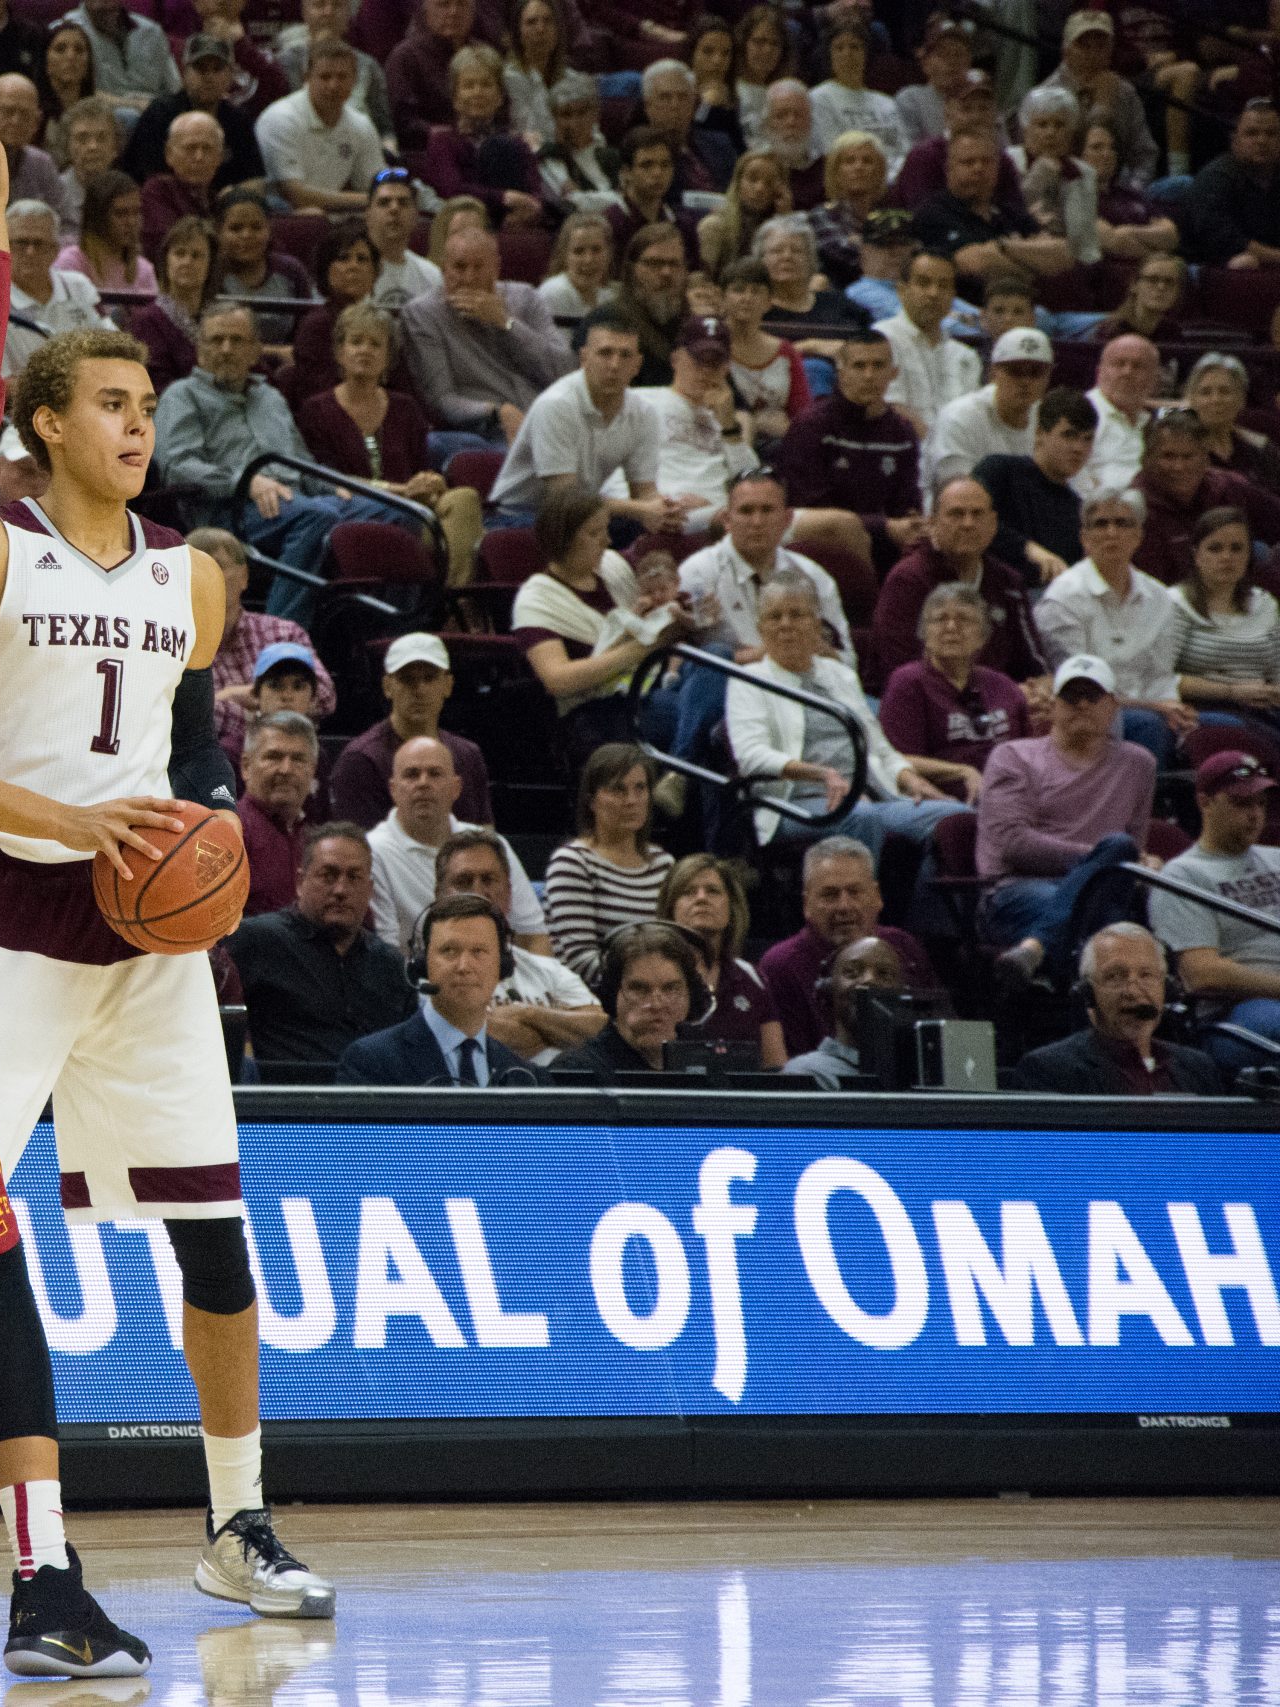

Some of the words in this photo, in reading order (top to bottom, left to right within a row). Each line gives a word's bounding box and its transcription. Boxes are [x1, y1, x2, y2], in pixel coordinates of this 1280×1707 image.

[35, 562, 62, 570] adidas
[23, 614, 130, 649] TEXAS
[142, 619, 187, 662] A&M
[90, 658, 124, 755] 1
[589, 1146, 758, 1404] of
[794, 1156, 1280, 1352] OMAH
[1139, 1416, 1231, 1428] DAKTRONICS
